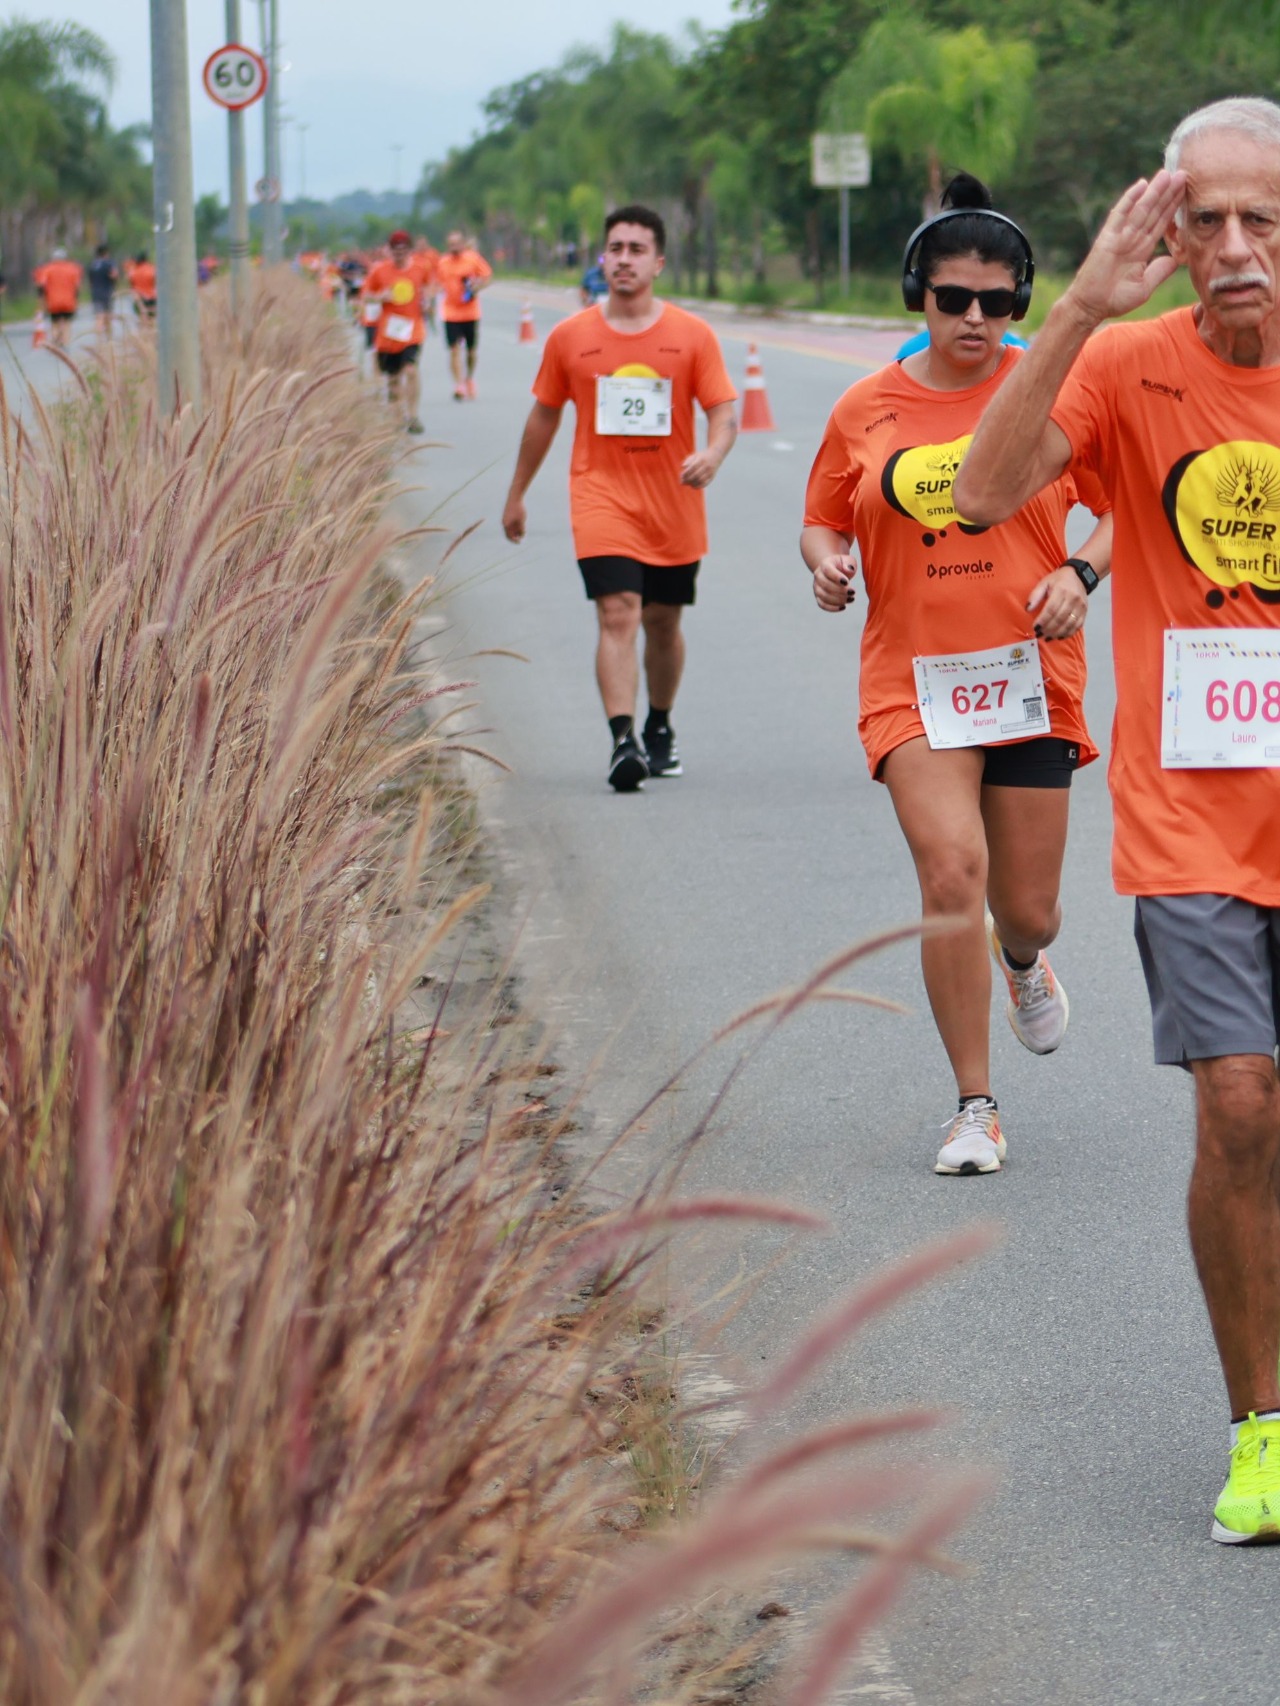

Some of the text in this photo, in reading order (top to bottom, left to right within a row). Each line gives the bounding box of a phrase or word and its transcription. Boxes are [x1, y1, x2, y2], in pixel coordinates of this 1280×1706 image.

[215, 60, 255, 88] 60
[622, 398, 646, 416] 29
[915, 480, 952, 495] SUP
[1201, 518, 1277, 542] SUPER
[939, 559, 993, 579] provale
[1216, 556, 1259, 571] smart
[951, 679, 1009, 715] 627
[972, 717, 998, 728] Mariana
[1232, 731, 1257, 743] Lauro
